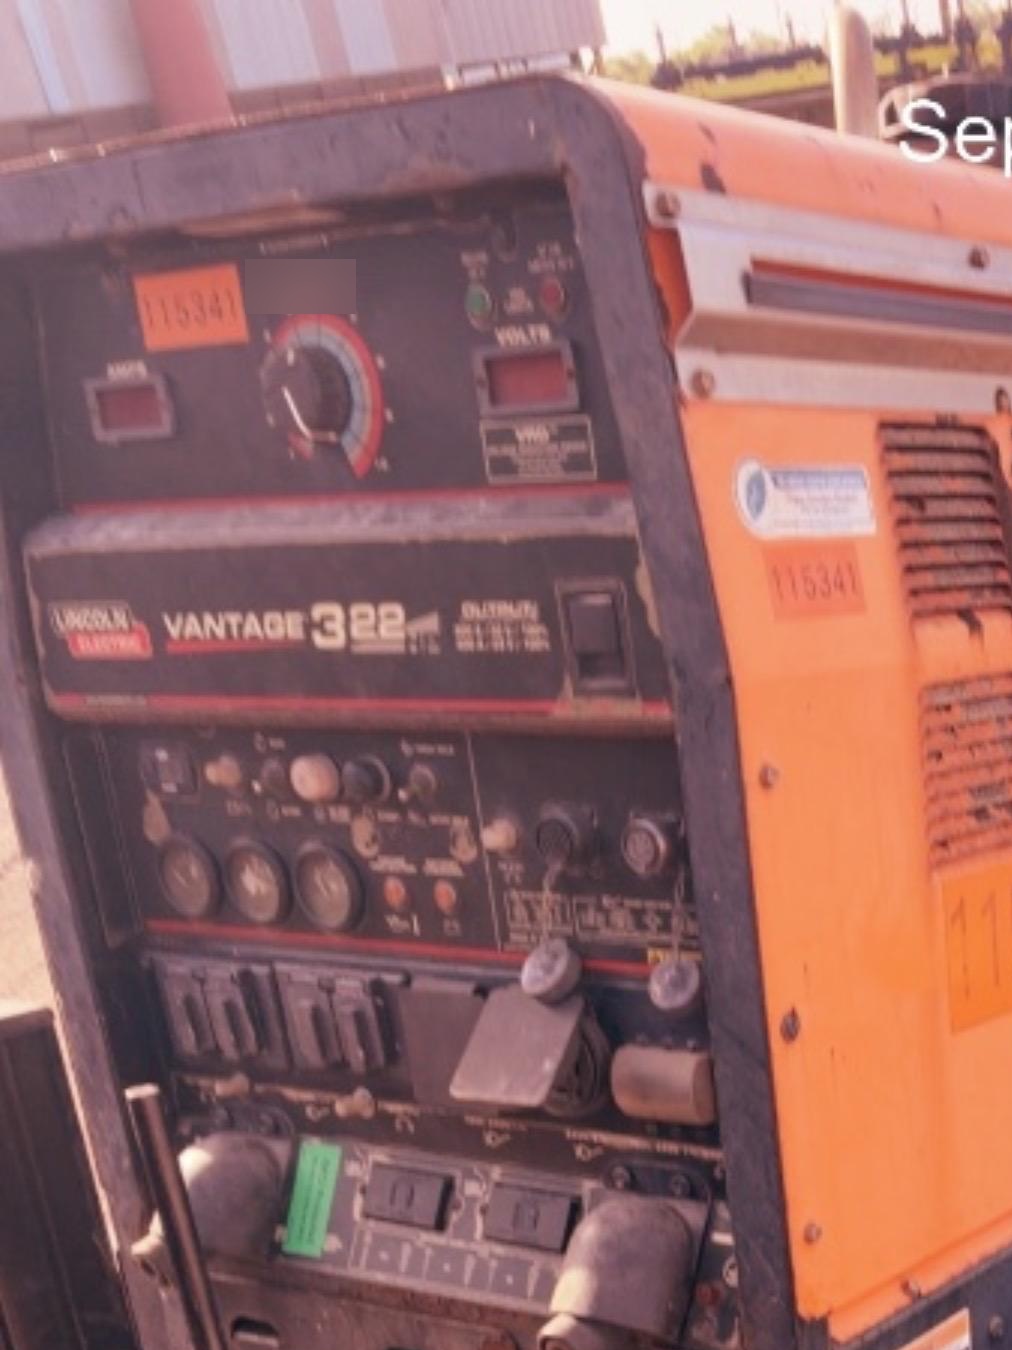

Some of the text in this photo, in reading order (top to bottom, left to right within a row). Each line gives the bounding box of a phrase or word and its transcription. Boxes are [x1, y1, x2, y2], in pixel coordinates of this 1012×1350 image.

[143, 287, 238, 331] 115341
[771, 561, 858, 601] 115341
[162, 611, 304, 640] VANTAGE
